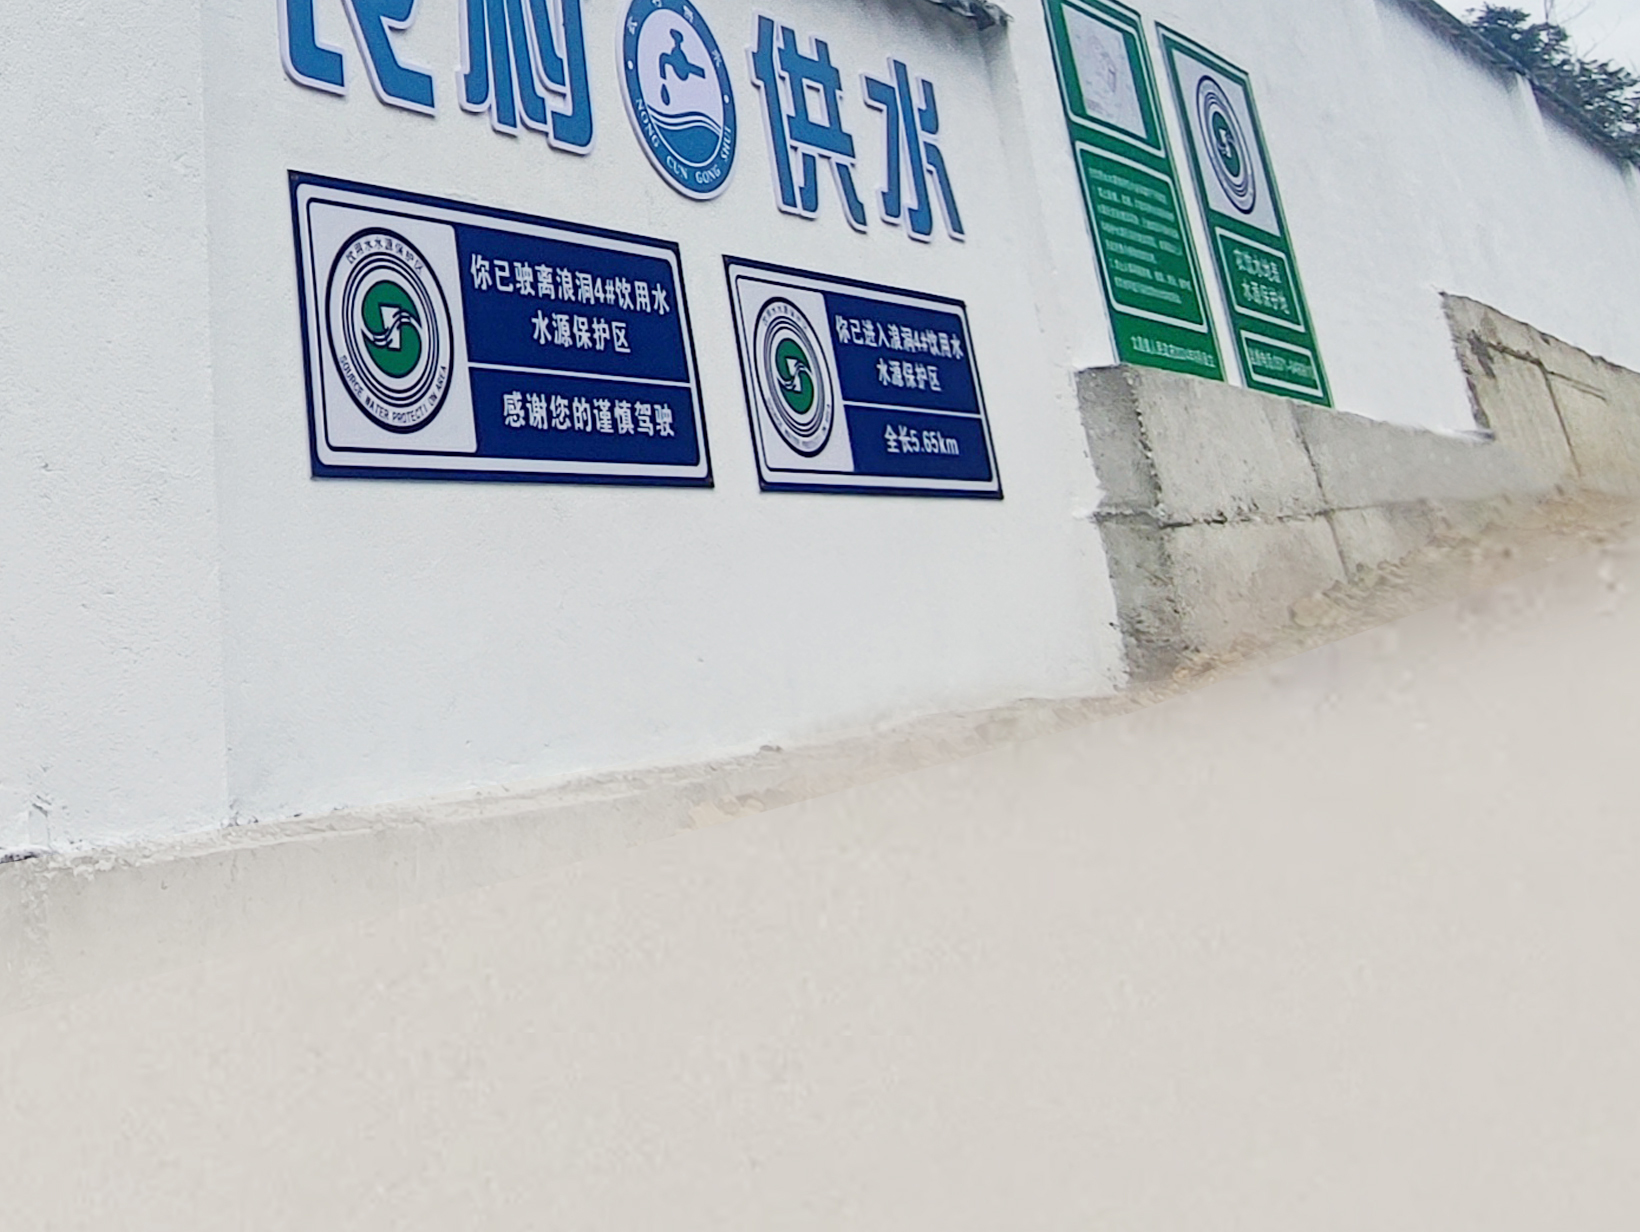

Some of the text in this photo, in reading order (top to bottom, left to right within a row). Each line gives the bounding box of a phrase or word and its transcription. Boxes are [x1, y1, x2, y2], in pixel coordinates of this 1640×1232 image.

[635, 98, 732, 184] NONG CUN GONG SHUI
[753, 12, 965, 243] 供水
[470, 253, 671, 316] 你已驶离浪洞4#饮用水
[531, 309, 631, 354] 水源保护区
[834, 314, 964, 360] 你已进入浪洞4#饮用水
[339, 354, 364, 398] SOURCE
[364, 396, 389, 420] WATER
[876, 358, 942, 392] 水源保护区
[502, 390, 675, 437] 感谢您的谨慎驾驶
[884, 424, 960, 456] 全长5.65km
